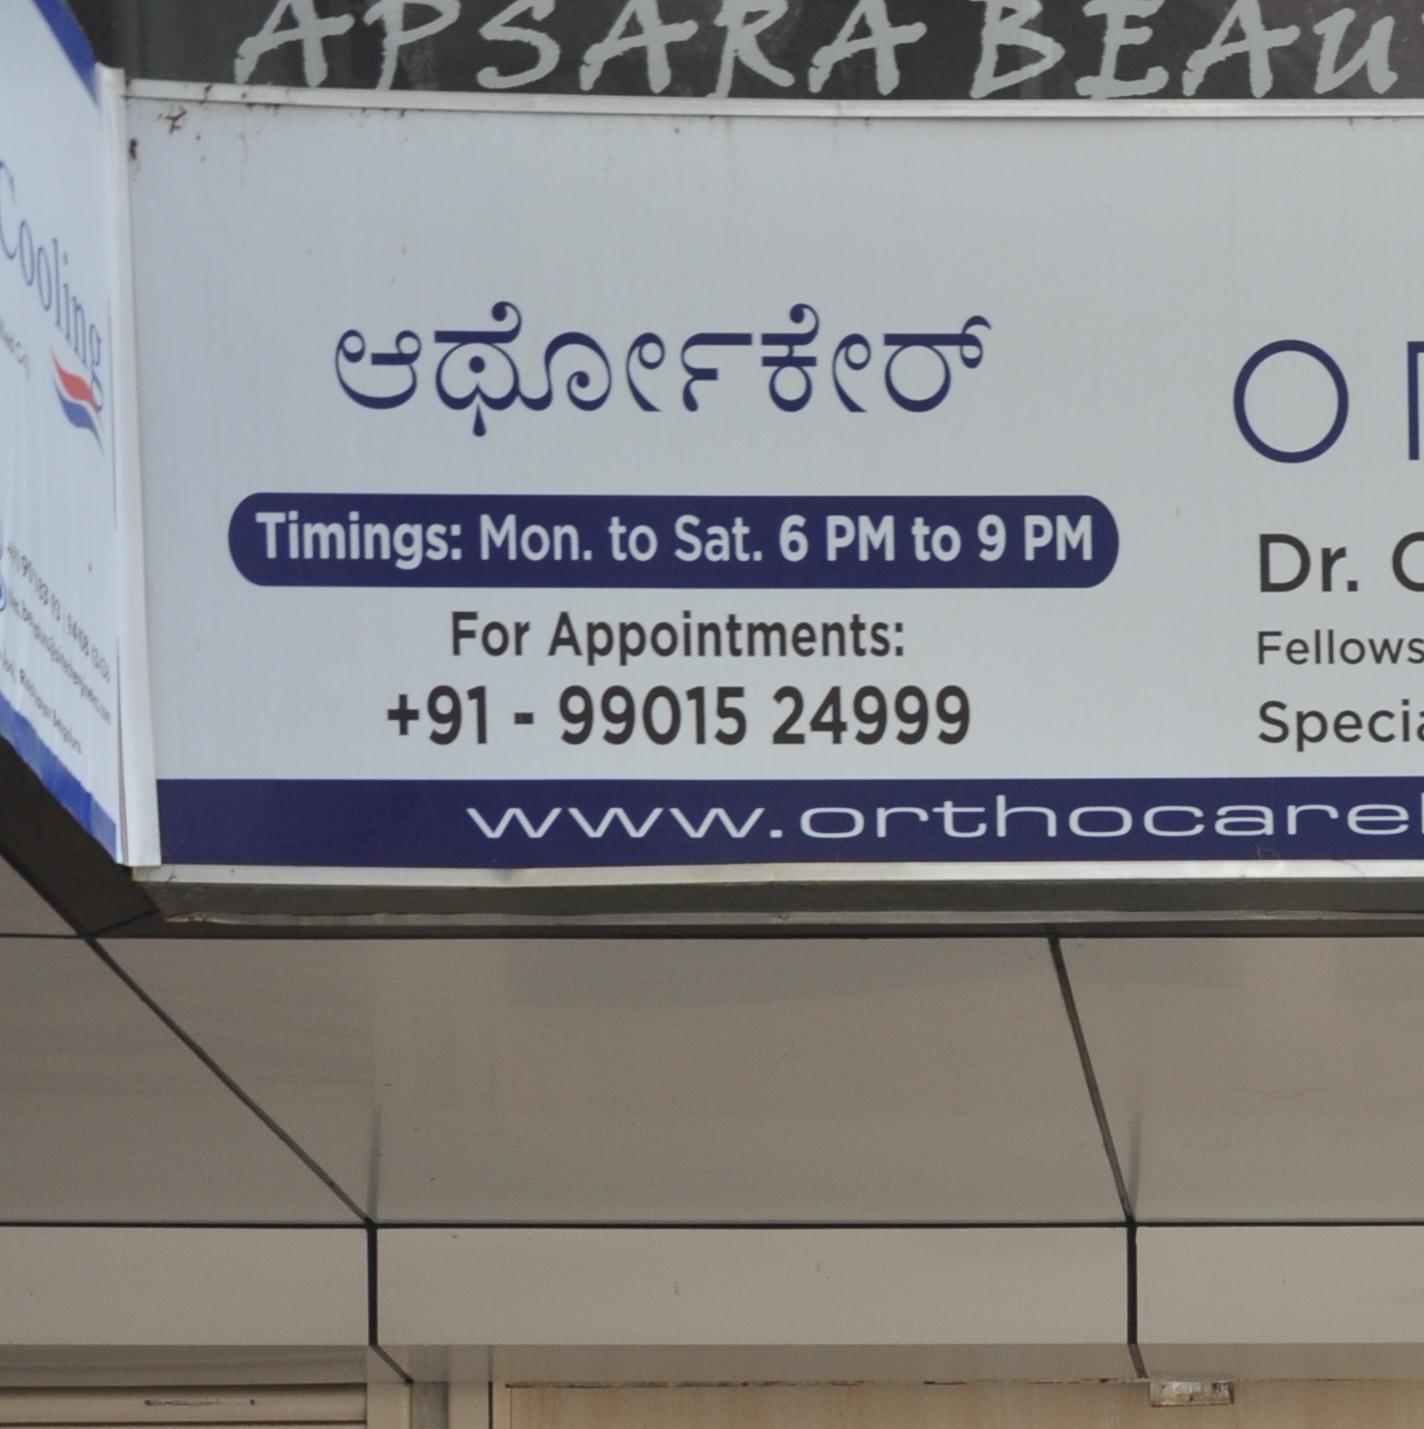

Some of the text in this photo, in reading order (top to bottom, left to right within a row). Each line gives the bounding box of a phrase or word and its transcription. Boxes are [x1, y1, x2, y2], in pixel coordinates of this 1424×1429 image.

[233, 0, 927, 98] APSARA
[255, 511, 1093, 569] Timings: Mon. to Sat. 6 PM to 9 PM
[1258, 532, 1359, 593] Dr.
[450, 610, 905, 667] For Appointments:
[386, 685, 490, 746] +91
[558, 685, 748, 747] 99015
[771, 685, 972, 747] 24999
